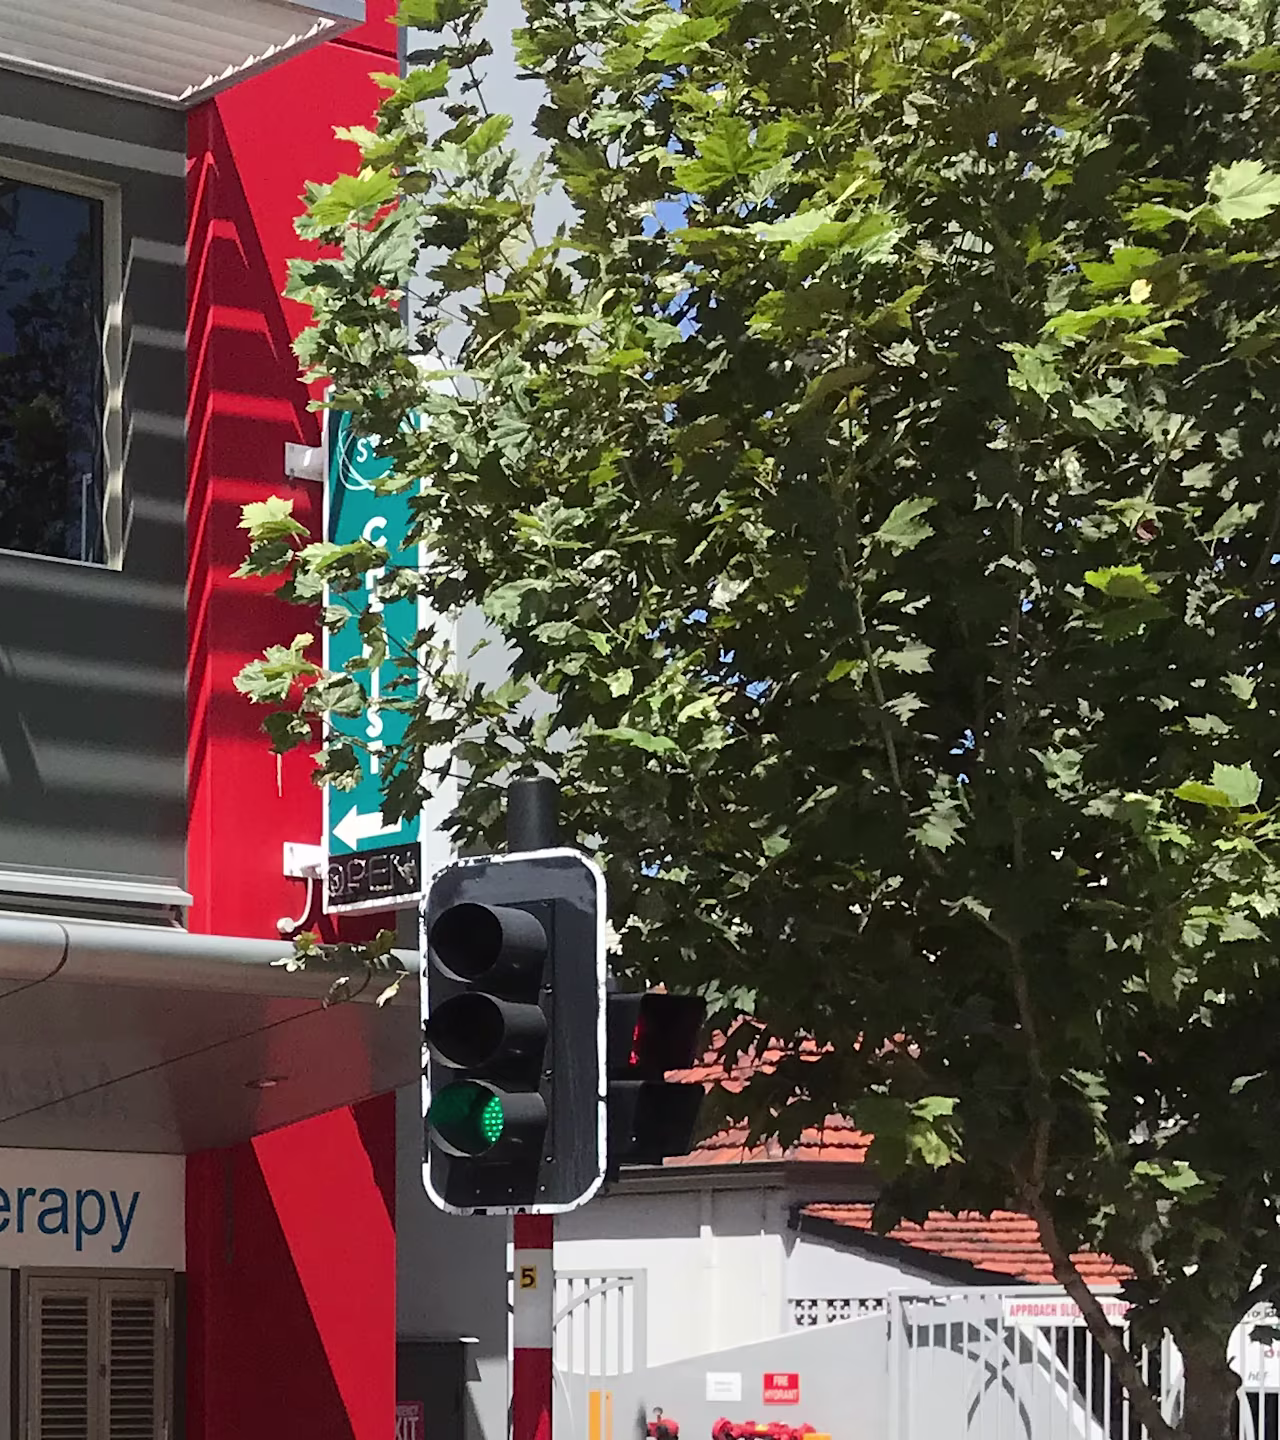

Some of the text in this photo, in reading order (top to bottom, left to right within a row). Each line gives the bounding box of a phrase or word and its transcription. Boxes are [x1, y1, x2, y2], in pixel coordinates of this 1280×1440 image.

[361, 516, 390, 774] CIST
[521, 1268, 536, 1288] 5
[1009, 1303, 1083, 1318] APPROACH SLO
[772, 1375, 789, 1387] FIRE
[764, 1388, 798, 1400] HYDRANT
